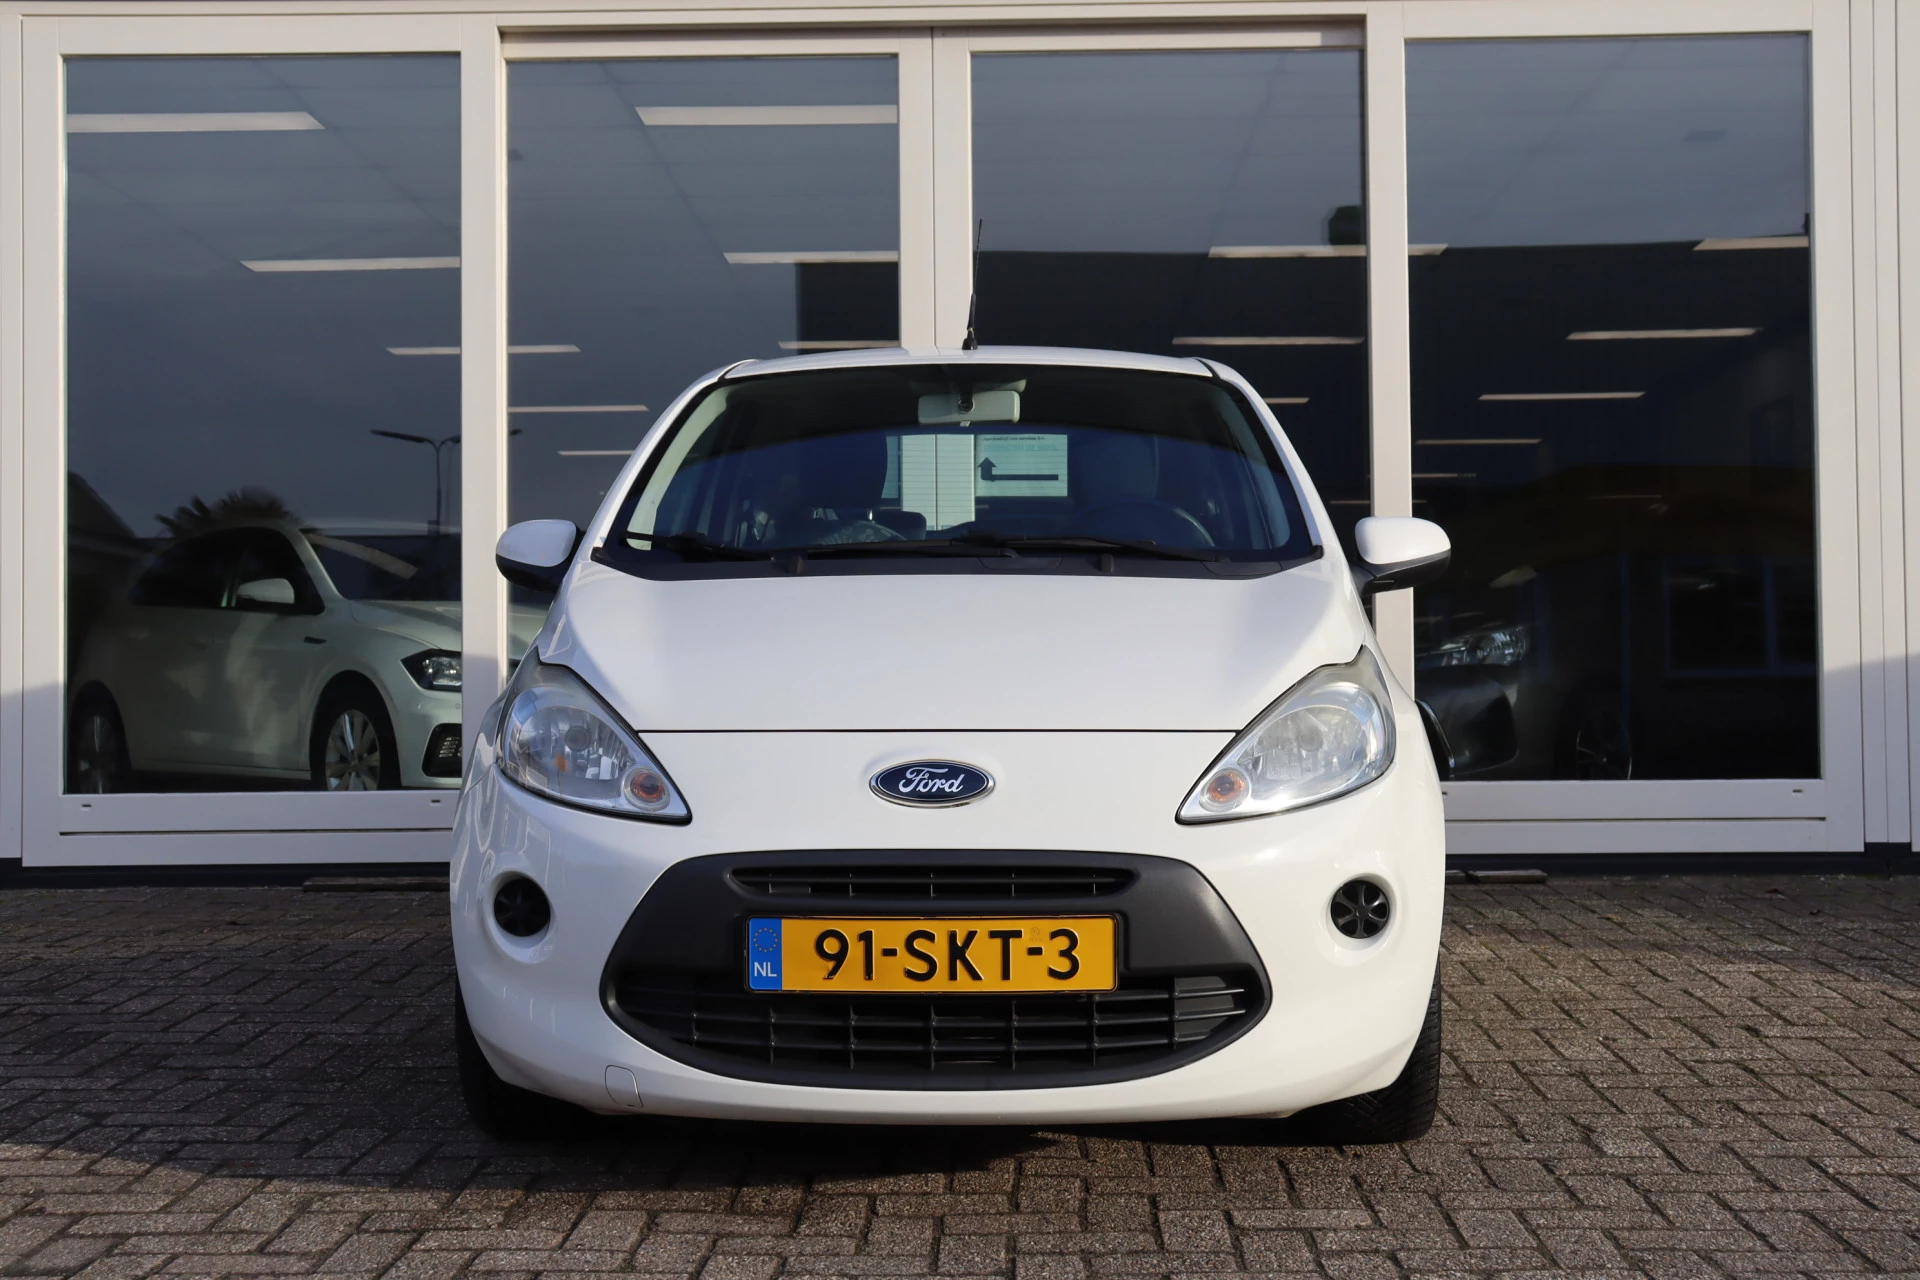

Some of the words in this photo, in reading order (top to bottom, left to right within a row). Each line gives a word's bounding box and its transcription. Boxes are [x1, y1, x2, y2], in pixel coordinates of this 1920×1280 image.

[899, 766, 965, 793] Ford
[814, 928, 1081, 981] 91-SKT-3
[754, 961, 778, 977] NL
